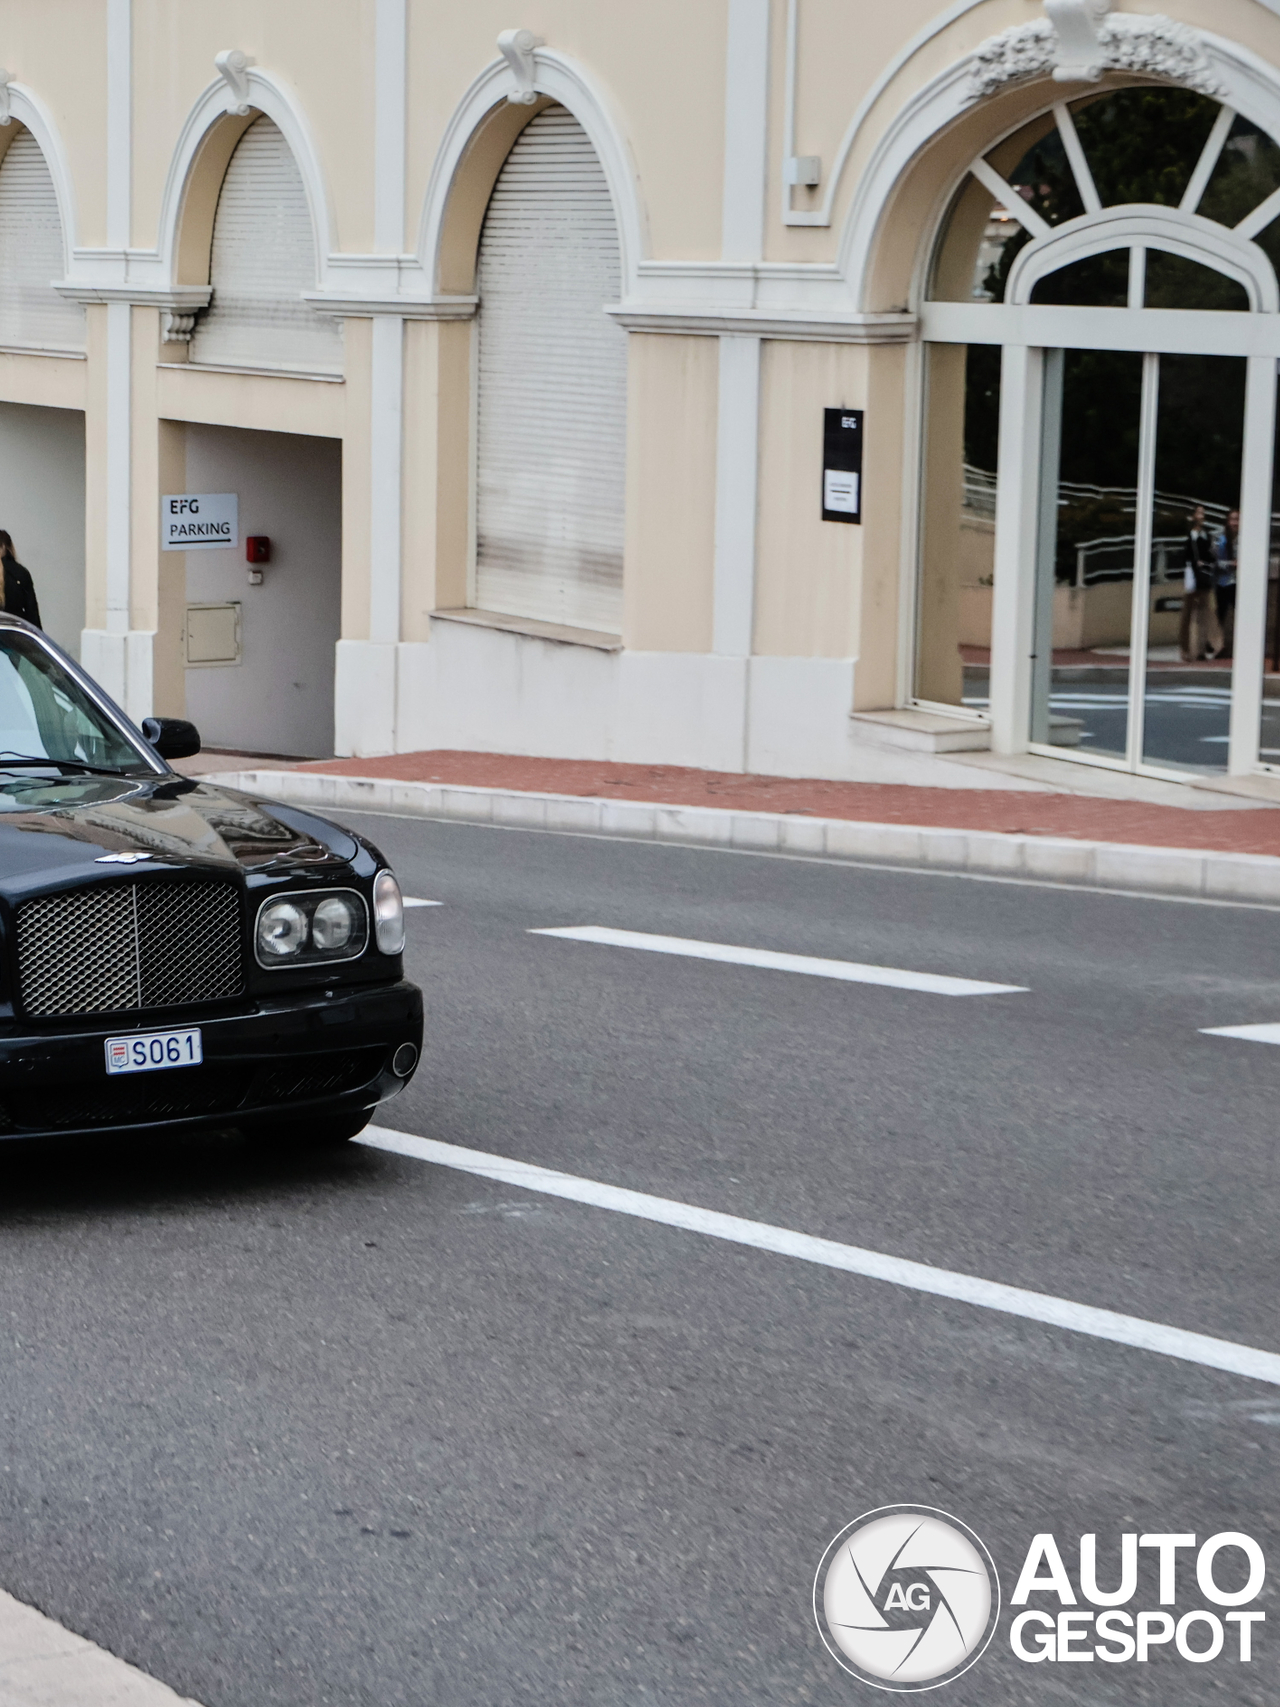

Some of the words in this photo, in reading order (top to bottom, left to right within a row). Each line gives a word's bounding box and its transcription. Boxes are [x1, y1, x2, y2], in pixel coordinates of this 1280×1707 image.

[170, 499, 199, 514] EFG
[170, 522, 230, 537] PARKING
[132, 1035, 194, 1066] S061
